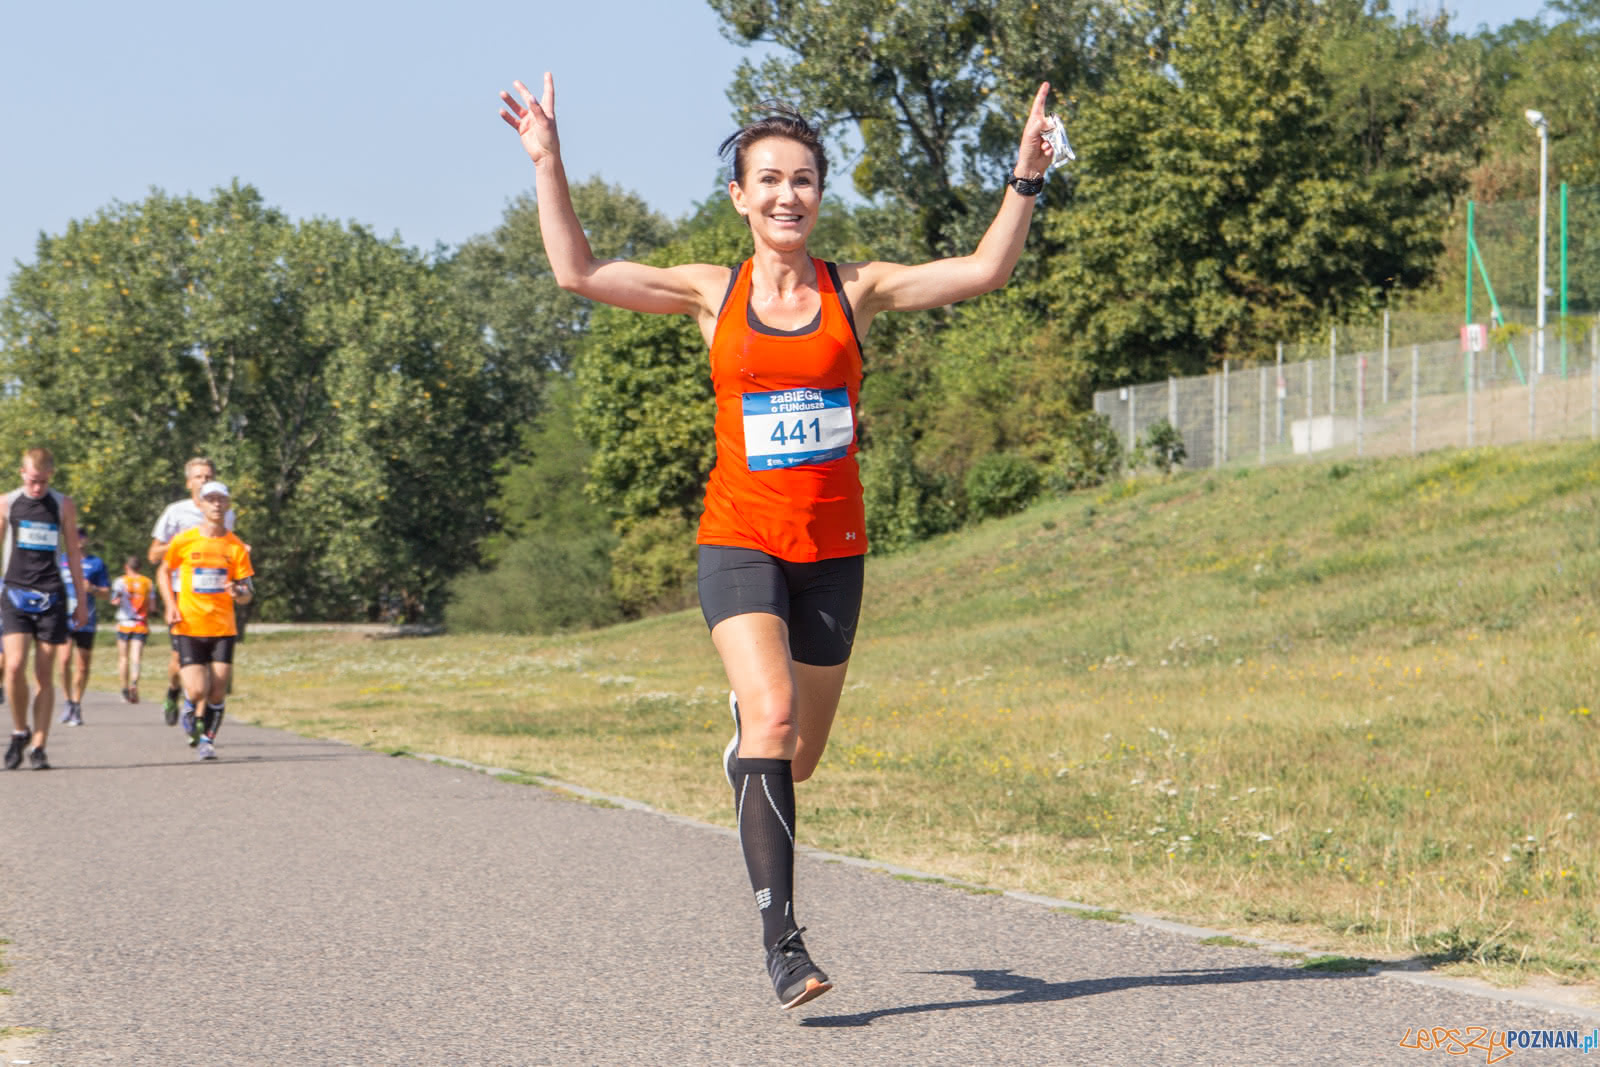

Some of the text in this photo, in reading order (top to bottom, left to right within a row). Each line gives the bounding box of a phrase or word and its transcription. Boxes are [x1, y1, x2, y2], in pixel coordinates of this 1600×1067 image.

[769, 390, 823, 404] zaBIEGaj
[779, 401, 825, 413] FUNdusze
[770, 417, 821, 446] 441
